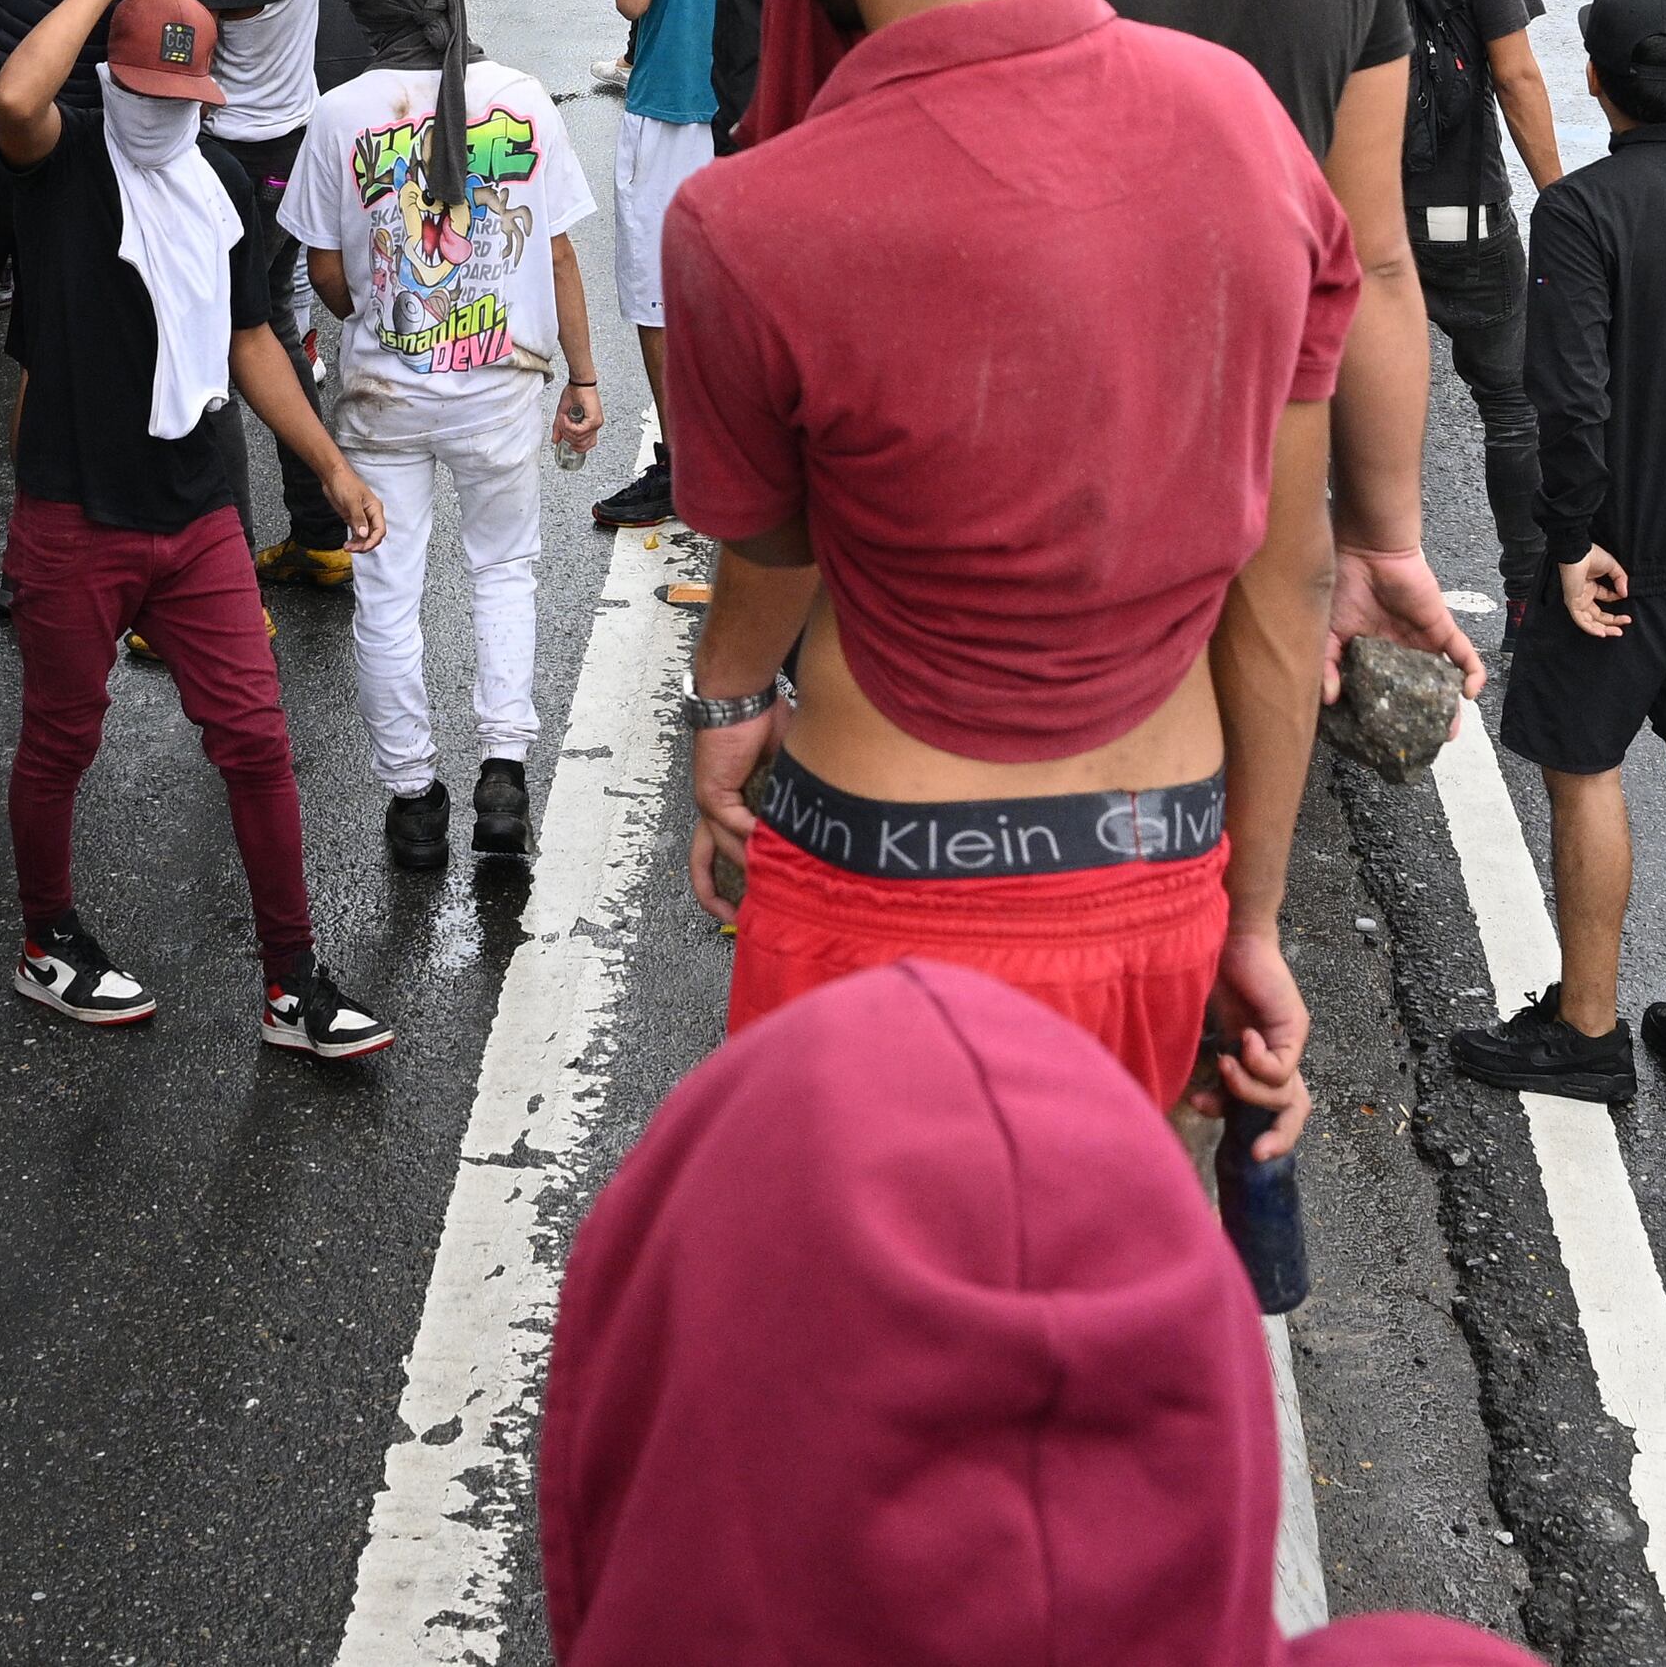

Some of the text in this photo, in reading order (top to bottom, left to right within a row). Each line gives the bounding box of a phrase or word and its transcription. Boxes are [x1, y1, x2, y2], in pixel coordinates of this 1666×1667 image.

[166, 32, 193, 51] CCS
[353, 108, 539, 208] SKTE
[379, 293, 496, 354] asmanian
[762, 775, 852, 861] alvin
[877, 813, 1061, 871] Klein
